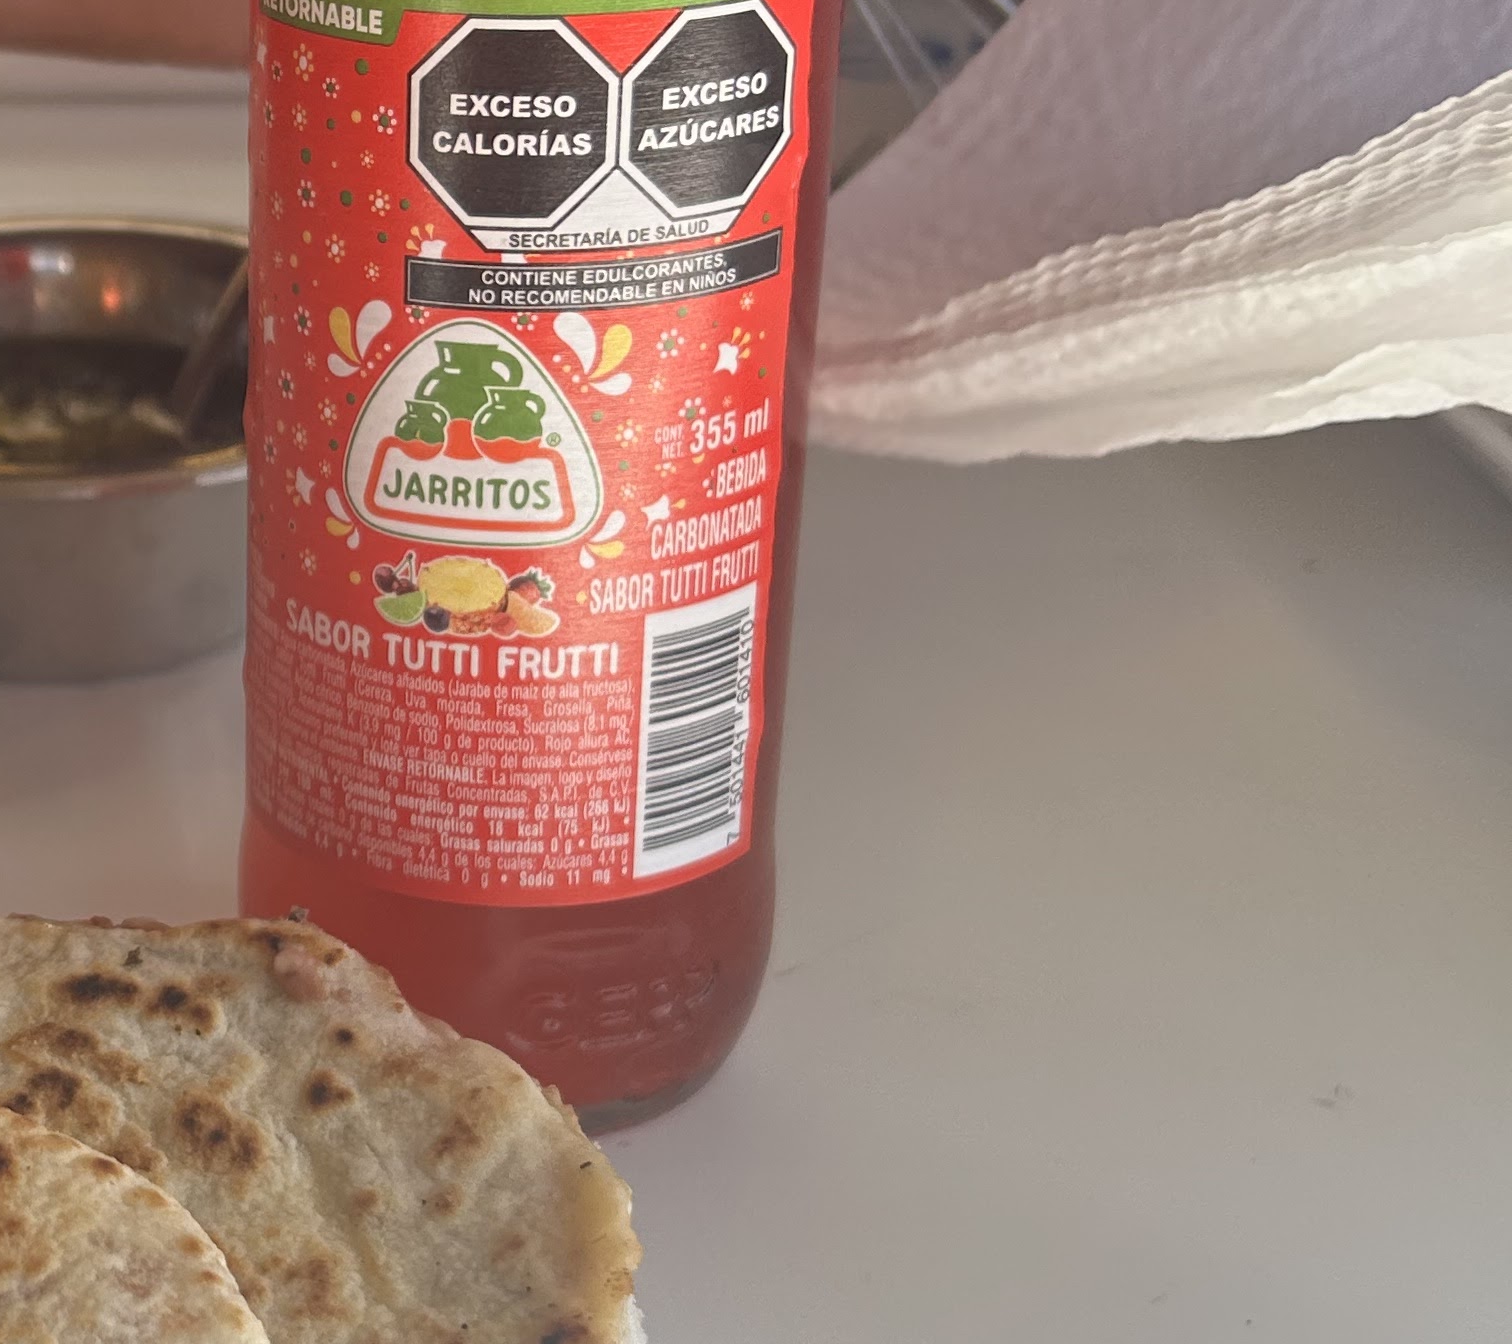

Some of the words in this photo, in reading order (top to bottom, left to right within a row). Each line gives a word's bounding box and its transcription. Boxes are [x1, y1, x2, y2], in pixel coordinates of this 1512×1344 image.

[449, 93, 577, 118] EXCESO
[661, 72, 768, 110] EXCESO
[432, 130, 593, 156] CALORÍAS
[638, 105, 780, 151] AZÚCARES
[508, 227, 623, 248] SECRETARÍA
[627, 229, 650, 244] DE
[654, 219, 709, 240] SALUD
[468, 288, 495, 305] NO
[501, 282, 657, 305] RECOMENDABLE
[662, 279, 685, 296] EN
[690, 268, 737, 291] NIÑOS
[481, 269, 577, 287] CONTIENE
[582, 253, 727, 284] EDULCORANTES,
[690, 410, 736, 454] 355
[743, 397, 770, 438] ml
[383, 468, 551, 510] JARRITOS
[716, 447, 766, 499] BEBIDA
[651, 495, 761, 560] CARBONATADA
[590, 573, 655, 615] SABOR
[660, 560, 708, 605] TUTTI
[711, 541, 760, 592] FRUTTI
[286, 599, 371, 659] SABOR
[382, 632, 480, 677] TUTTI
[497, 642, 619, 680] FRUTTI
[737, 618, 754, 704] 601410
[397, 672, 444, 694] añadidos
[449, 679, 490, 698] (Jarabe
[494, 684, 508, 698] de
[542, 684, 555, 699] de
[559, 682, 579, 698] alta
[393, 706, 406, 723] de
[409, 708, 442, 730] sodio,
[446, 712, 519, 736] Polidextrosa,
[524, 716, 579, 735] Sucralosa
[609, 714, 626, 730] mg
[405, 691, 426, 709] Uva
[437, 697, 484, 716] morada,
[496, 701, 532, 719] Fresa,
[419, 725, 437, 744] 100
[444, 732, 451, 749] g
[458, 733, 471, 749] de
[545, 735, 571, 752] Rojo
[363, 750, 403, 773] ENVASE
[492, 771, 506, 784] La
[510, 771, 554, 788] imagen,
[559, 769, 583, 786] logo
[596, 762, 632, 782] diseño
[402, 745, 420, 758] ver
[424, 744, 447, 764] tapa
[451, 751, 458, 763] o
[463, 749, 496, 768] cuello
[501, 752, 517, 768] del
[569, 747, 632, 768] Consérvese
[729, 727, 749, 807] 501441
[406, 776, 439, 797] Frutas
[589, 784, 603, 799] de
[344, 792, 397, 822] Contenido
[410, 811, 473, 834] energético
[488, 821, 504, 836] 18
[518, 821, 544, 837] kcal
[558, 819, 578, 837] (75
[592, 817, 610, 834] kJ)
[395, 793, 454, 815] energético
[459, 804, 478, 818] por
[534, 804, 549, 820] 62
[554, 802, 578, 818] kcal
[441, 832, 481, 851] Grasas
[487, 837, 544, 854] saturadas
[550, 837, 558, 852] 0
[564, 840, 572, 855] g
[591, 832, 629, 850] Grasas
[454, 853, 468, 867] de
[474, 854, 491, 867] los
[543, 855, 592, 869] Azúcares
[620, 850, 629, 865] g
[461, 870, 469, 883] 0
[480, 873, 488, 889] g
[519, 871, 554, 887] Sodio
[567, 871, 580, 885] 11
[592, 868, 610, 884] mg
